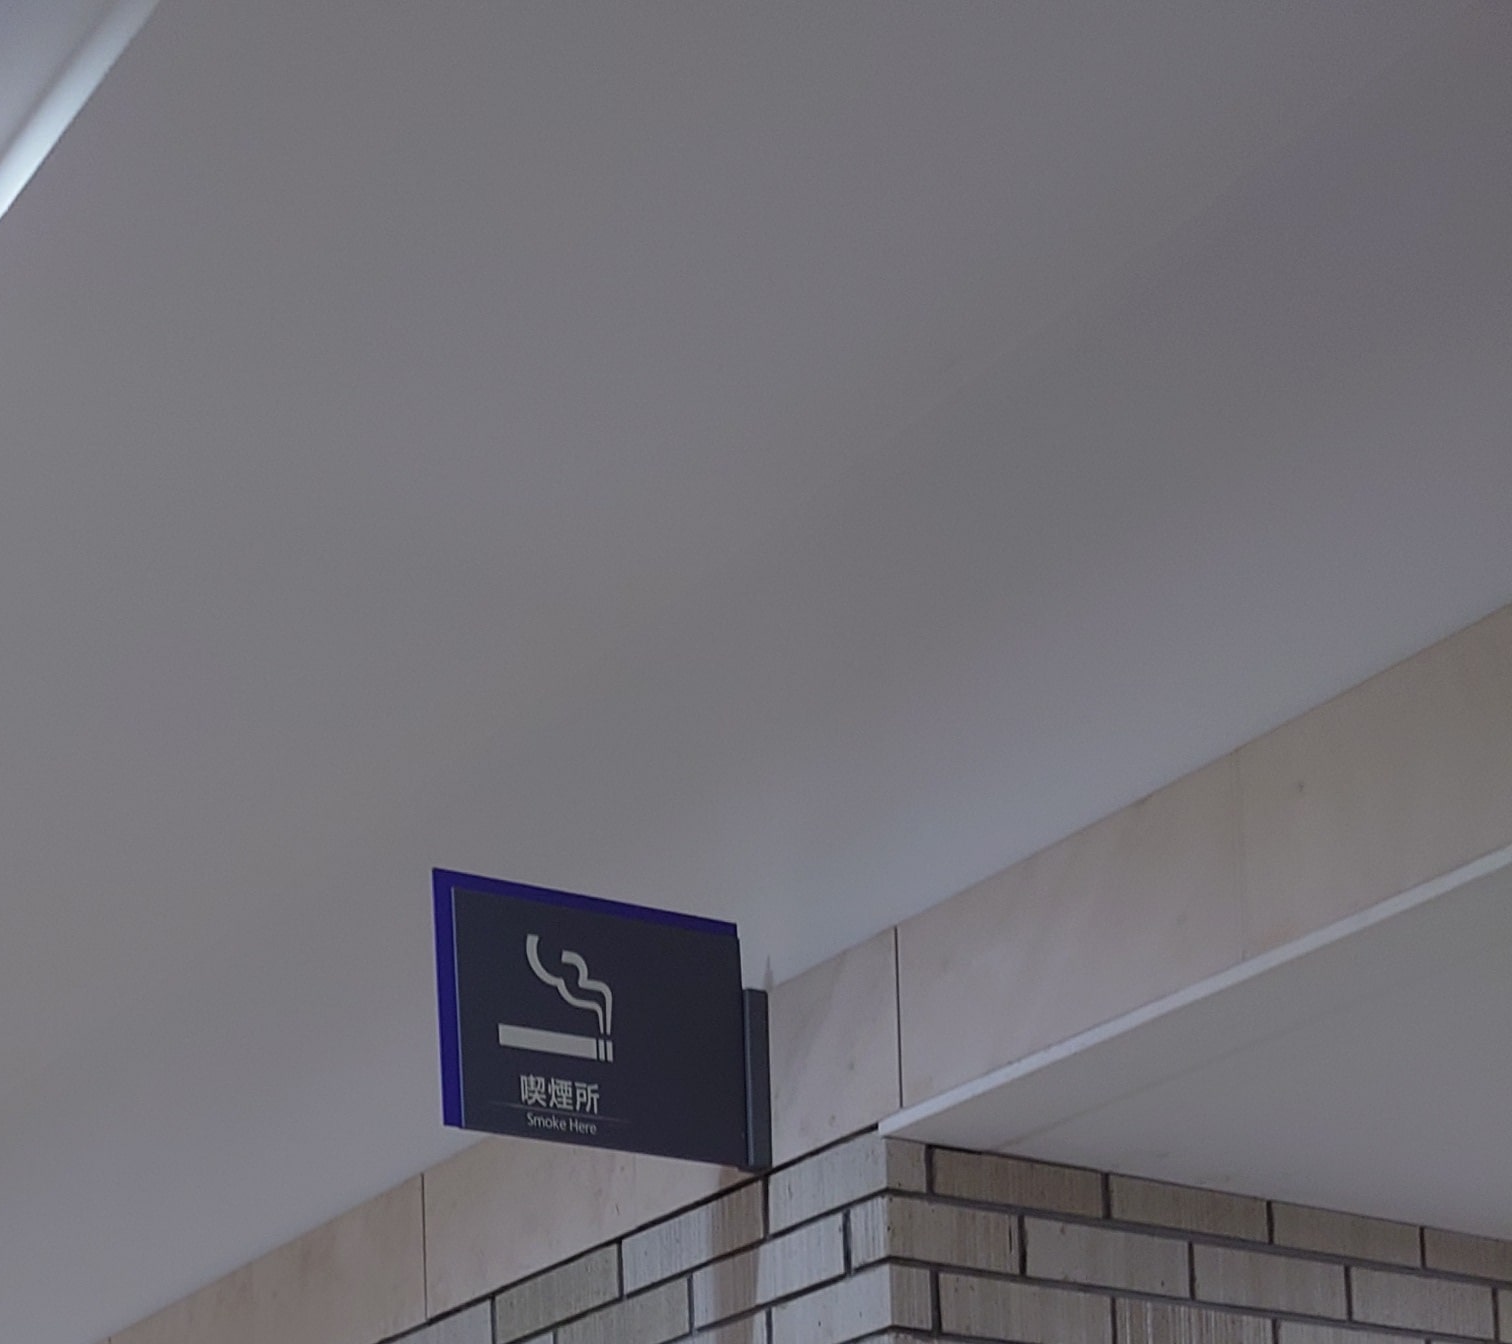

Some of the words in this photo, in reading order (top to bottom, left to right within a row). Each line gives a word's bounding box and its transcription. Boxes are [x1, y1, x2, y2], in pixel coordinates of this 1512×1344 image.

[520, 1074, 600, 1115] 喫煙所
[527, 1112, 567, 1131] Smoke
[569, 1117, 597, 1135] Here
